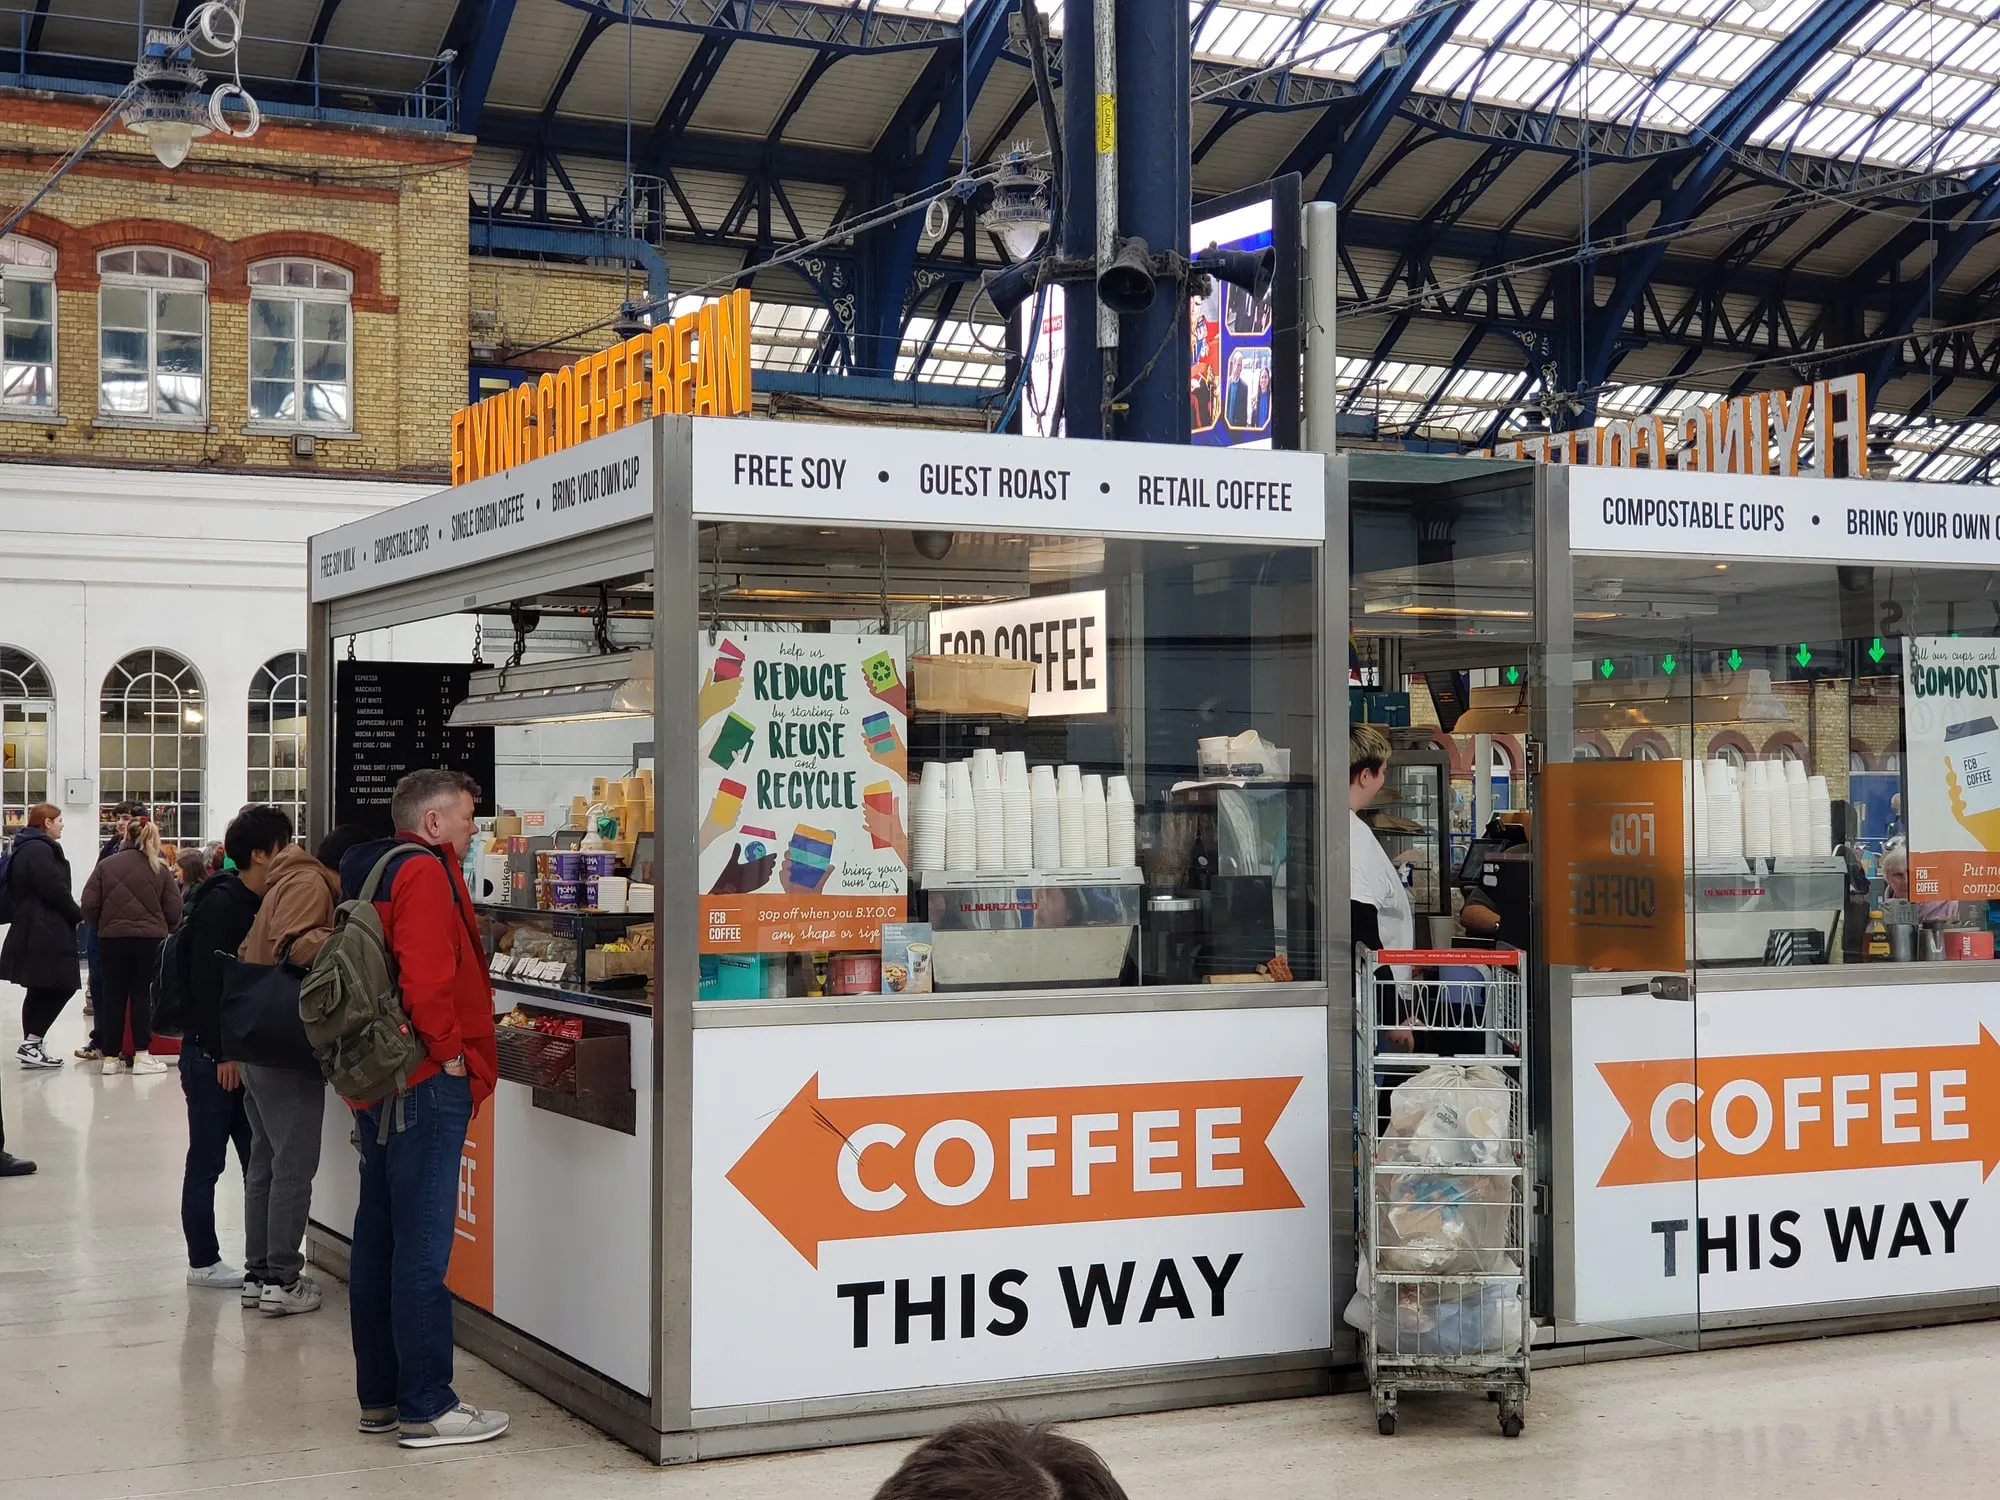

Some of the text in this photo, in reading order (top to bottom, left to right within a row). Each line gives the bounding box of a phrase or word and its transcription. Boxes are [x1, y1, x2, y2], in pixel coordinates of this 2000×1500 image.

[452, 288, 751, 488] FLYING COFFEE BEAN
[552, 456, 640, 513] BRING YOUR OWN CUP
[734, 453, 847, 491] FREE SOY
[920, 462, 1071, 501] GUEST ROAST
[1138, 475, 1293, 512] RETAIL COFFEE
[451, 493, 525, 542] SINGLE ORIGIN COFFEE
[1602, 496, 1785, 533] COMPOSTABLE CUPS
[1846, 508, 1898, 538] BRING
[1902, 511, 1948, 540] YOUR
[1952, 512, 1991, 541] OWN
[374, 524, 430, 564] COMPOSTABLE CUPS
[320, 546, 356, 578] FREE SOY MILK
[779, 642, 825, 660] help us
[1932, 652, 1948, 660] our
[1952, 652, 1974, 664] cups
[1978, 646, 1998, 660] and
[754, 660, 849, 702] REDUCE
[1914, 664, 2000, 699] COMPOST
[772, 704, 850, 722] by starting to
[768, 720, 845, 760] REUSE
[794, 757, 817, 770] and
[1964, 758, 1978, 772] FCB
[1966, 770, 1992, 786] COFFEE
[756, 768, 858, 810] RECYCLE
[842, 861, 903, 878] bring your
[842, 878, 890, 892] own cup
[1916, 870, 1928, 879] FCB
[1962, 862, 1984, 876] Put
[557, 886, 577, 894] MOMA
[1916, 882, 1939, 893] COFFEE
[710, 912, 726, 924] FCB
[758, 906, 896, 922] 30p off when you B.Y.O.C
[708, 926, 741, 941] COFFEE
[772, 931, 796, 944] any
[800, 926, 836, 944] shape
[840, 930, 853, 939] or
[858, 928, 880, 944] size
[1650, 1069, 1970, 1159] COFFEE
[836, 1106, 1244, 1212] COFFEE
[1651, 1198, 1970, 1278] THIS WAY
[836, 1252, 1244, 1348] THIS WAY
